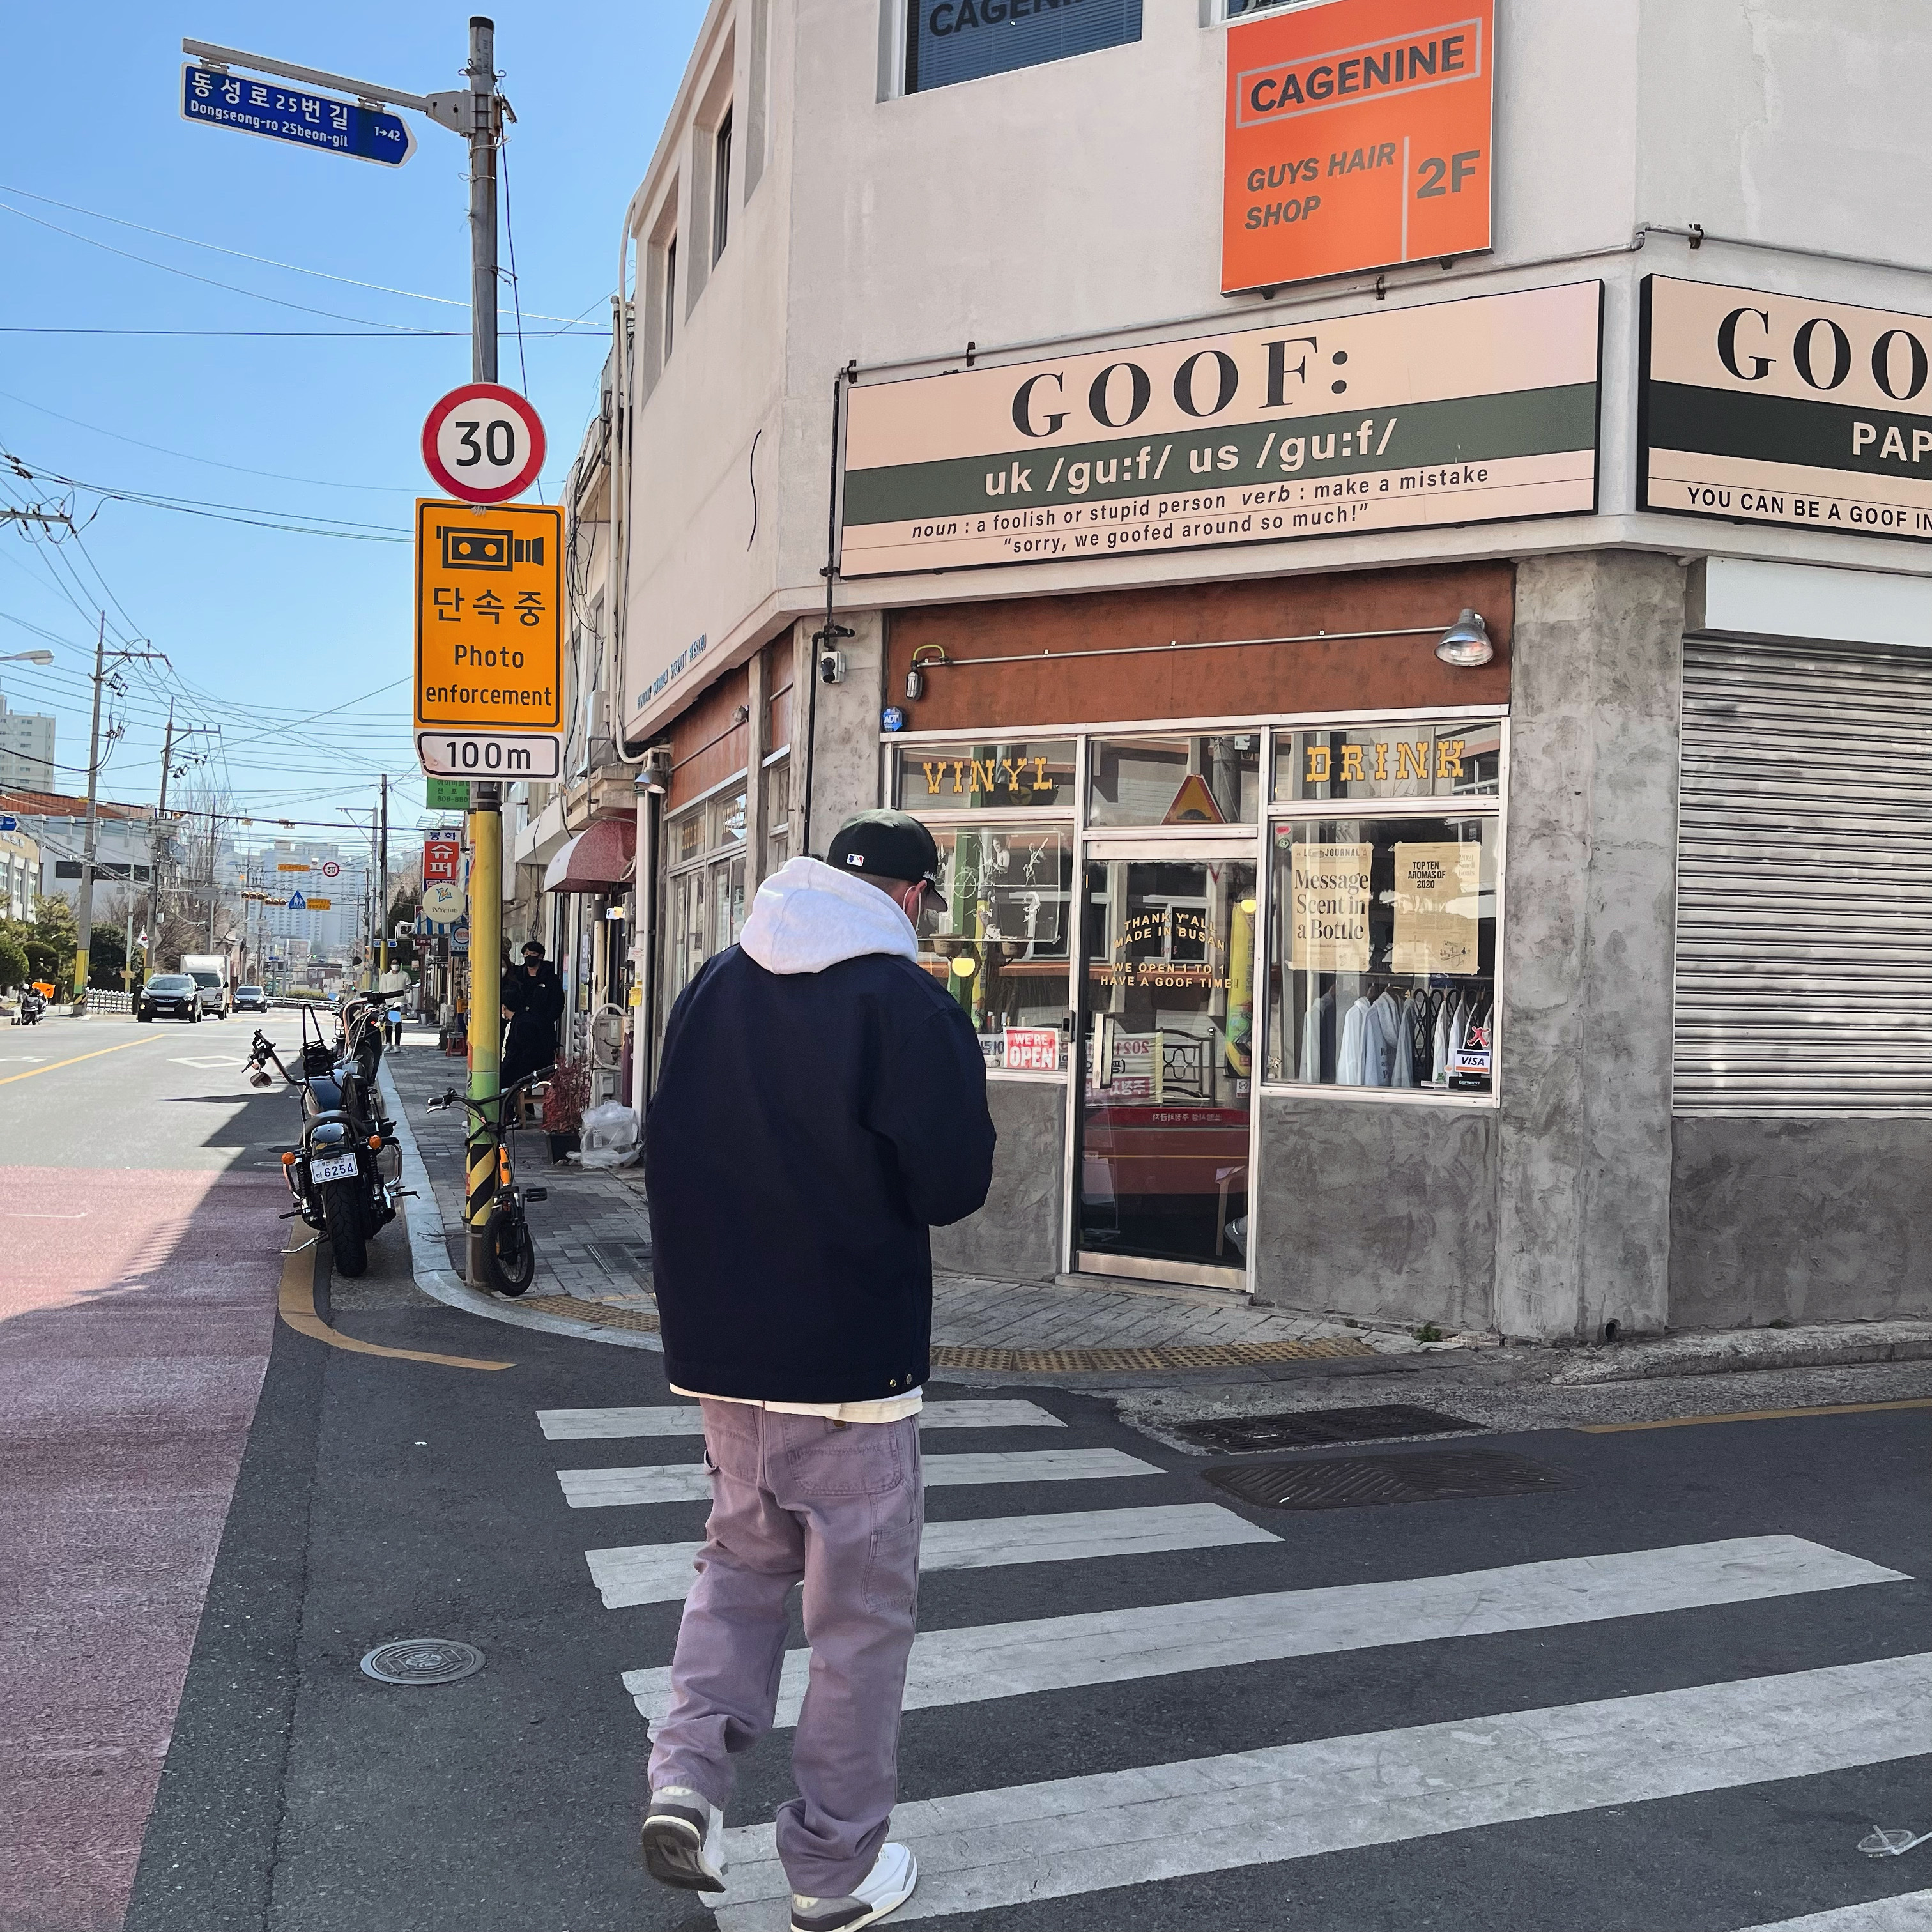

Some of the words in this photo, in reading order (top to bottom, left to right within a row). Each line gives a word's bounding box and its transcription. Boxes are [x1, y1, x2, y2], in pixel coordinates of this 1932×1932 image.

[929, 0, 1084, 36] CAGE
[1251, 35, 1465, 112] CAGENINE
[190, 100, 279, 131] Dongseong-ro
[282, 121, 348, 148] 25beon-gil
[1246, 158, 1320, 192] GUYS
[1327, 142, 1397, 178] HAIR
[1416, 150, 1480, 199] 2F
[1245, 196, 1321, 230] SHOP
[1012, 336, 1348, 438] GOOF:
[455, 420, 515, 466] 30
[985, 461, 1032, 496] uk
[1046, 445, 1172, 495] /gu:f/
[1189, 444, 1239, 473] us
[1256, 418, 1397, 472] /gu:f/
[912, 521, 958, 539] noun
[977, 519, 986, 532] a
[993, 509, 1056, 531] foolish
[1064, 510, 1082, 525] or
[1090, 499, 1149, 521] stupid
[1159, 494, 1226, 518] person
[1241, 484, 1290, 506] verb
[1315, 477, 1369, 498] make
[1379, 478, 1389, 491] a
[1400, 466, 1489, 490] mistake
[1687, 487, 1731, 508] YOU
[1740, 493, 1783, 514] CAN
[1794, 500, 1819, 518] BE
[1828, 503, 1841, 520] A
[1850, 505, 1907, 527] GOOF
[1075, 532, 1099, 547] we
[1107, 518, 1173, 548] goofed
[1182, 515, 1252, 538] around
[1261, 516, 1283, 530] so
[434, 587, 545, 626] 단속중
[455, 644, 524, 668] Photo
[426, 684, 553, 707] enforcement
[884, 714, 899, 724] ADT
[447, 742, 530, 770] 100m
[1306, 740, 1465, 782] DRINK
[923, 757, 1053, 793] VINYL
[430, 844, 453, 877] 슈퍼
[1325, 848, 1360, 857] JOURNAL
[1413, 861, 1426, 870] TOP
[1427, 861, 1439, 870] TEN
[1295, 869, 1369, 895] Message
[1408, 871, 1436, 879] AROMAS
[1437, 871, 1446, 879] OF
[1417, 880, 1435, 889] 2020
[1297, 894, 1345, 915] Scent
[1349, 896, 1365, 914] in
[1124, 912, 1170, 931] THANK
[1297, 923, 1307, 939] a
[1311, 918, 1364, 939] Bottle
[1114, 928, 1151, 949] MADE
[1158, 926, 1171, 936] IN
[1179, 926, 1225, 951] BUSAN
[1112, 962, 1132, 972] WE
[1138, 963, 1175, 973] OPEN
[1194, 964, 1212, 974] TO
[1101, 976, 1135, 986] HAVE
[1140, 977, 1149, 986] A
[1154, 977, 1193, 988] GOOF
[1200, 978, 1238, 988] TIME!
[1009, 1045, 1053, 1068] OPEN
[1461, 1057, 1485, 1066] VISA
[324, 1163, 353, 1177] 6254
